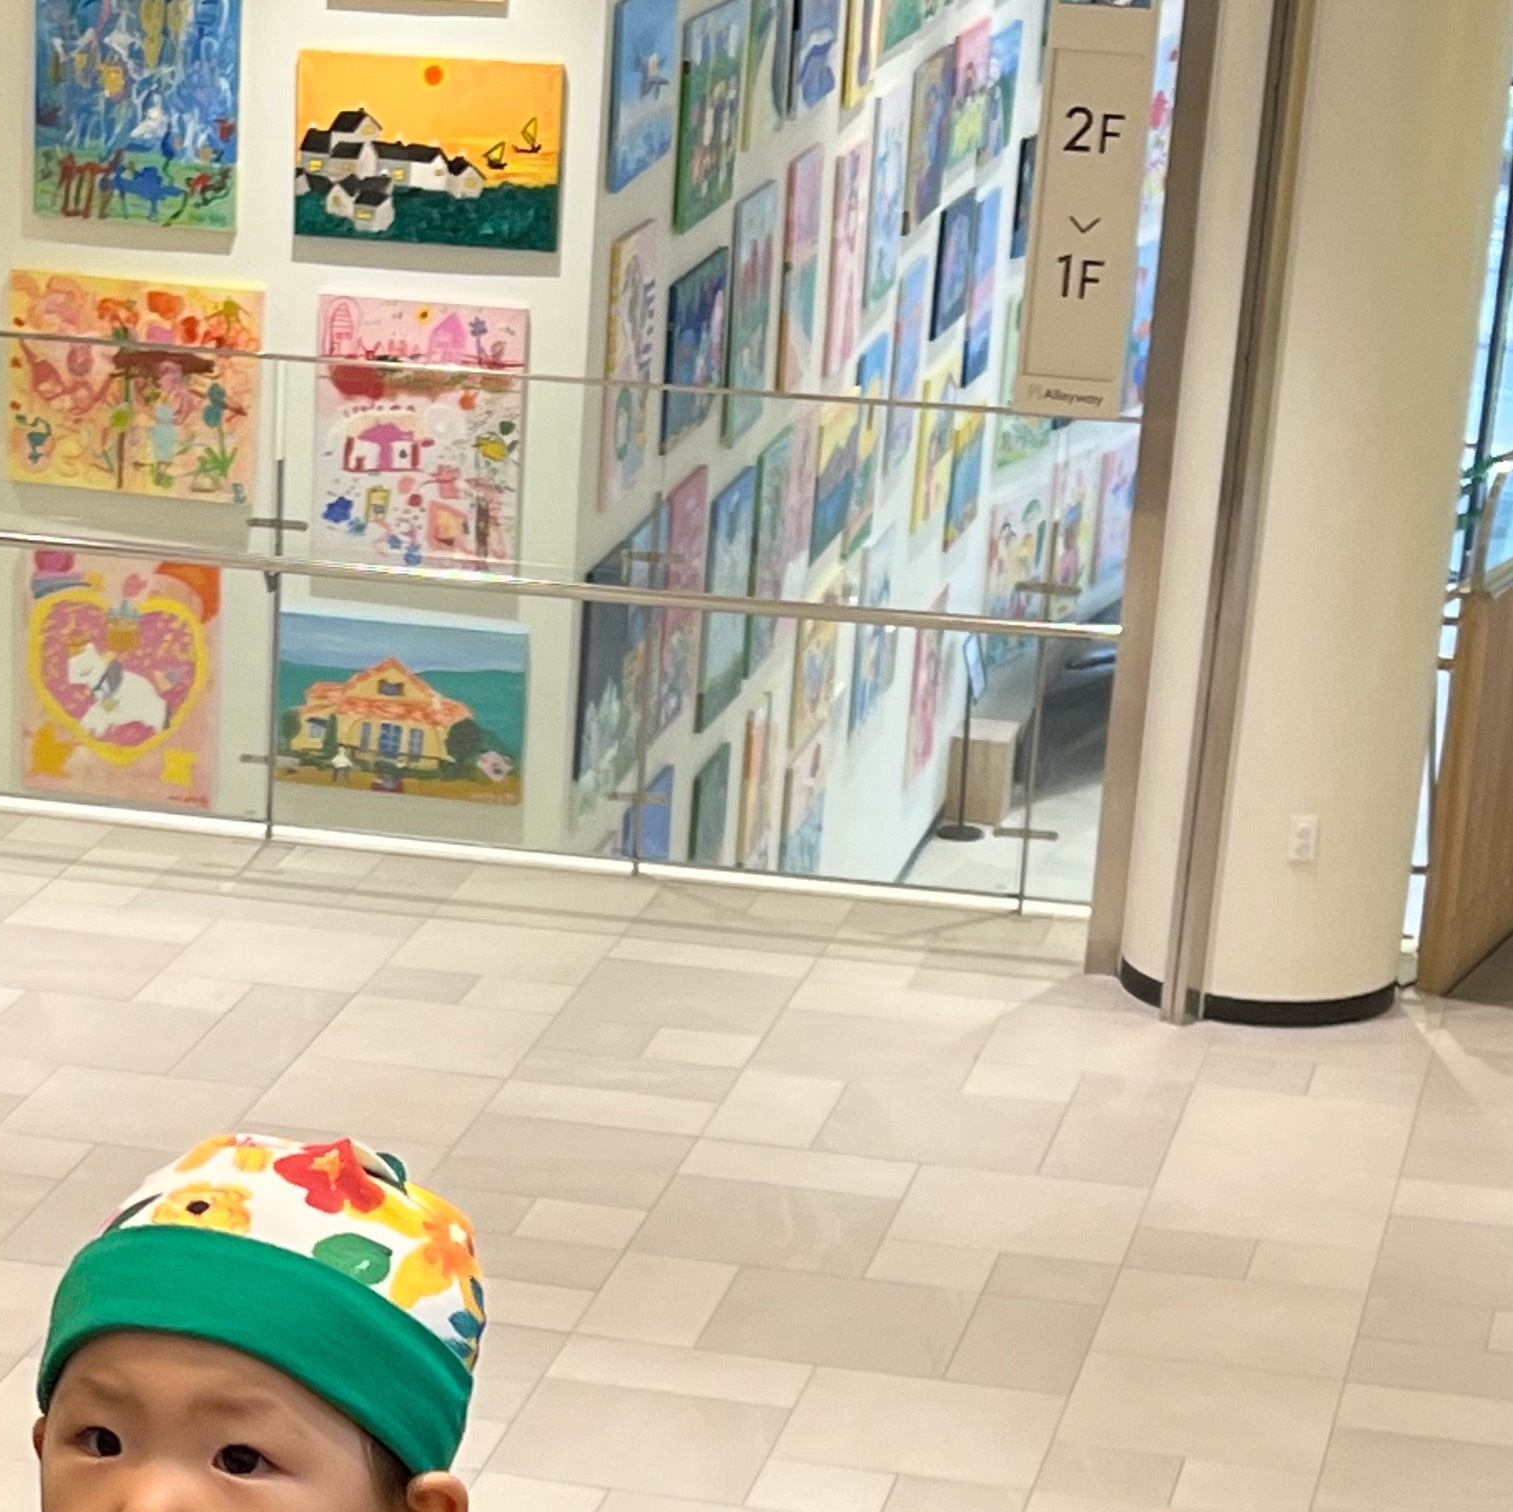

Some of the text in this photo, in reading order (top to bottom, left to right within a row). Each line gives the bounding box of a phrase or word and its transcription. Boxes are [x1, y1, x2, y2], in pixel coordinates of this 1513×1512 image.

[1062, 106, 1126, 154] 2F
[1057, 253, 1106, 300] 1F
[1043, 387, 1105, 408] Alleyway
